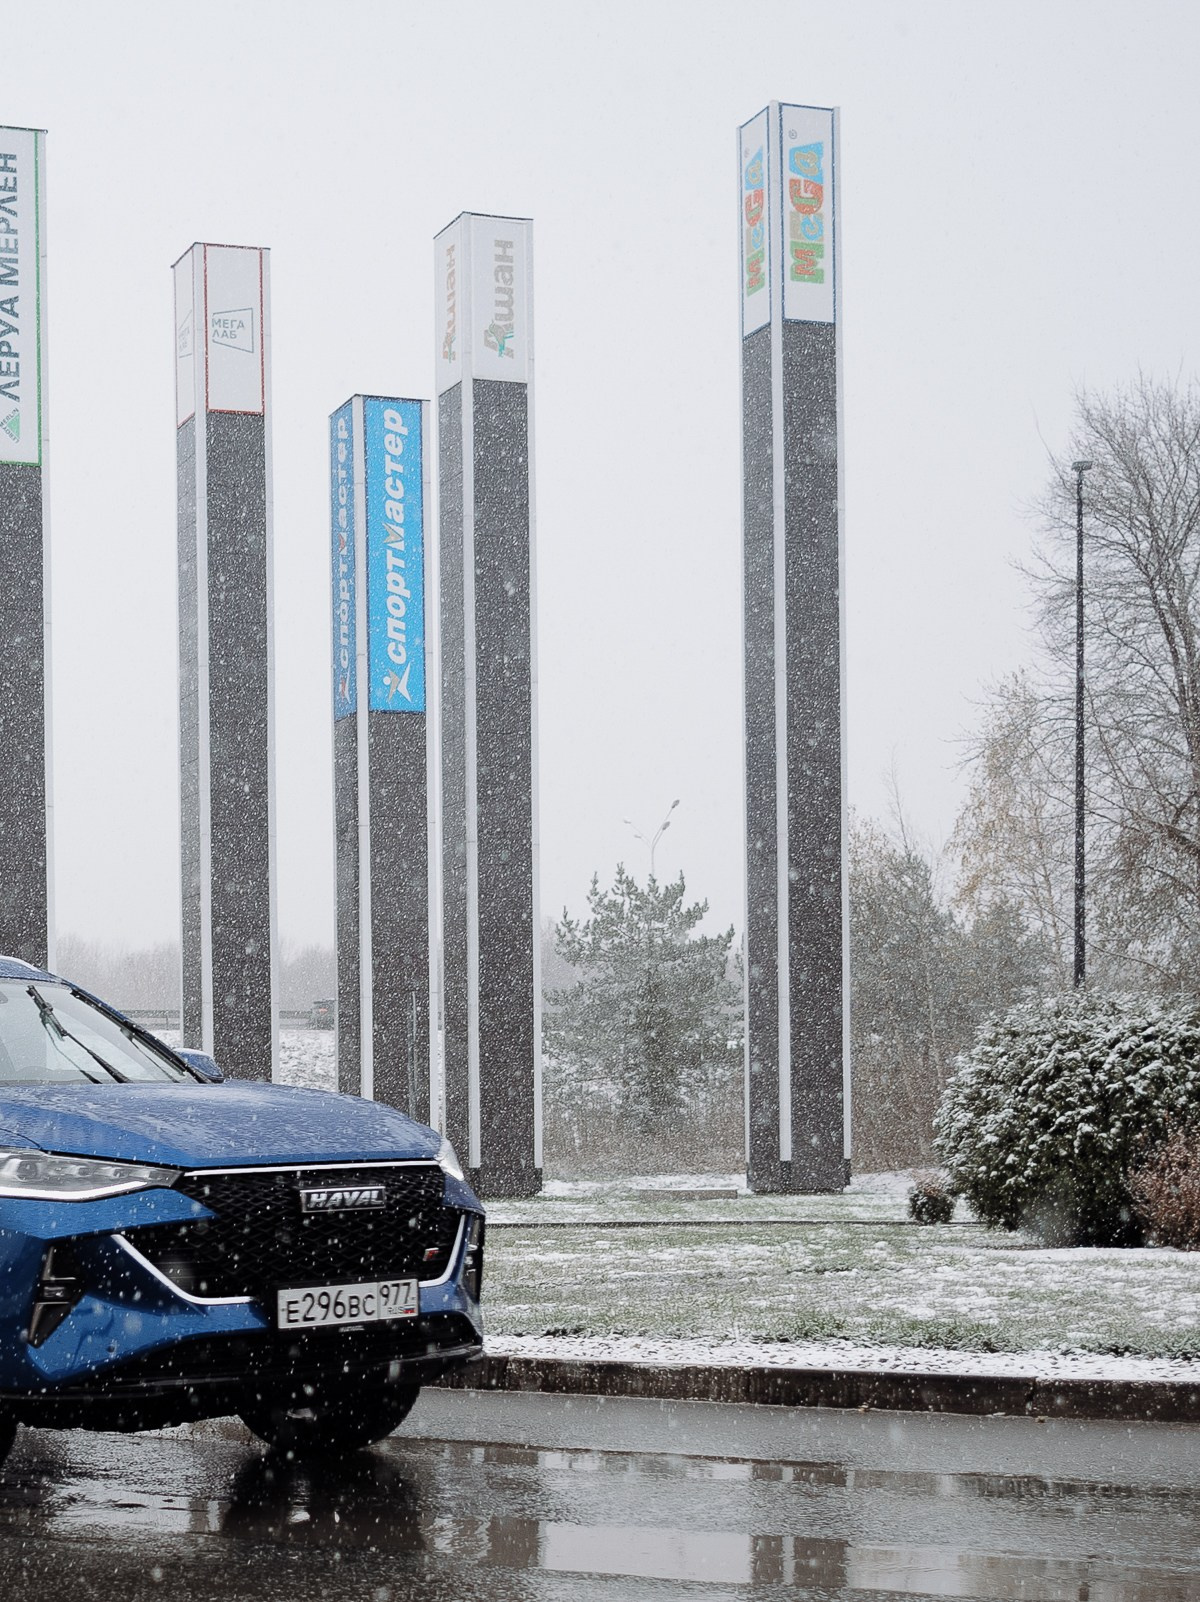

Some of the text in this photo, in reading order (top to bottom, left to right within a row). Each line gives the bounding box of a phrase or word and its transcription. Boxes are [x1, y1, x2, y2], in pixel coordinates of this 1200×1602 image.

[211, 318, 245, 330] МЕГА
[212, 329, 237, 340] ЛАБ
[2, 426, 20, 444] LEROY
[309, 1190, 381, 1208] HAVAL
[379, 1282, 412, 1306] 977
[388, 1305, 404, 1315] RUS
